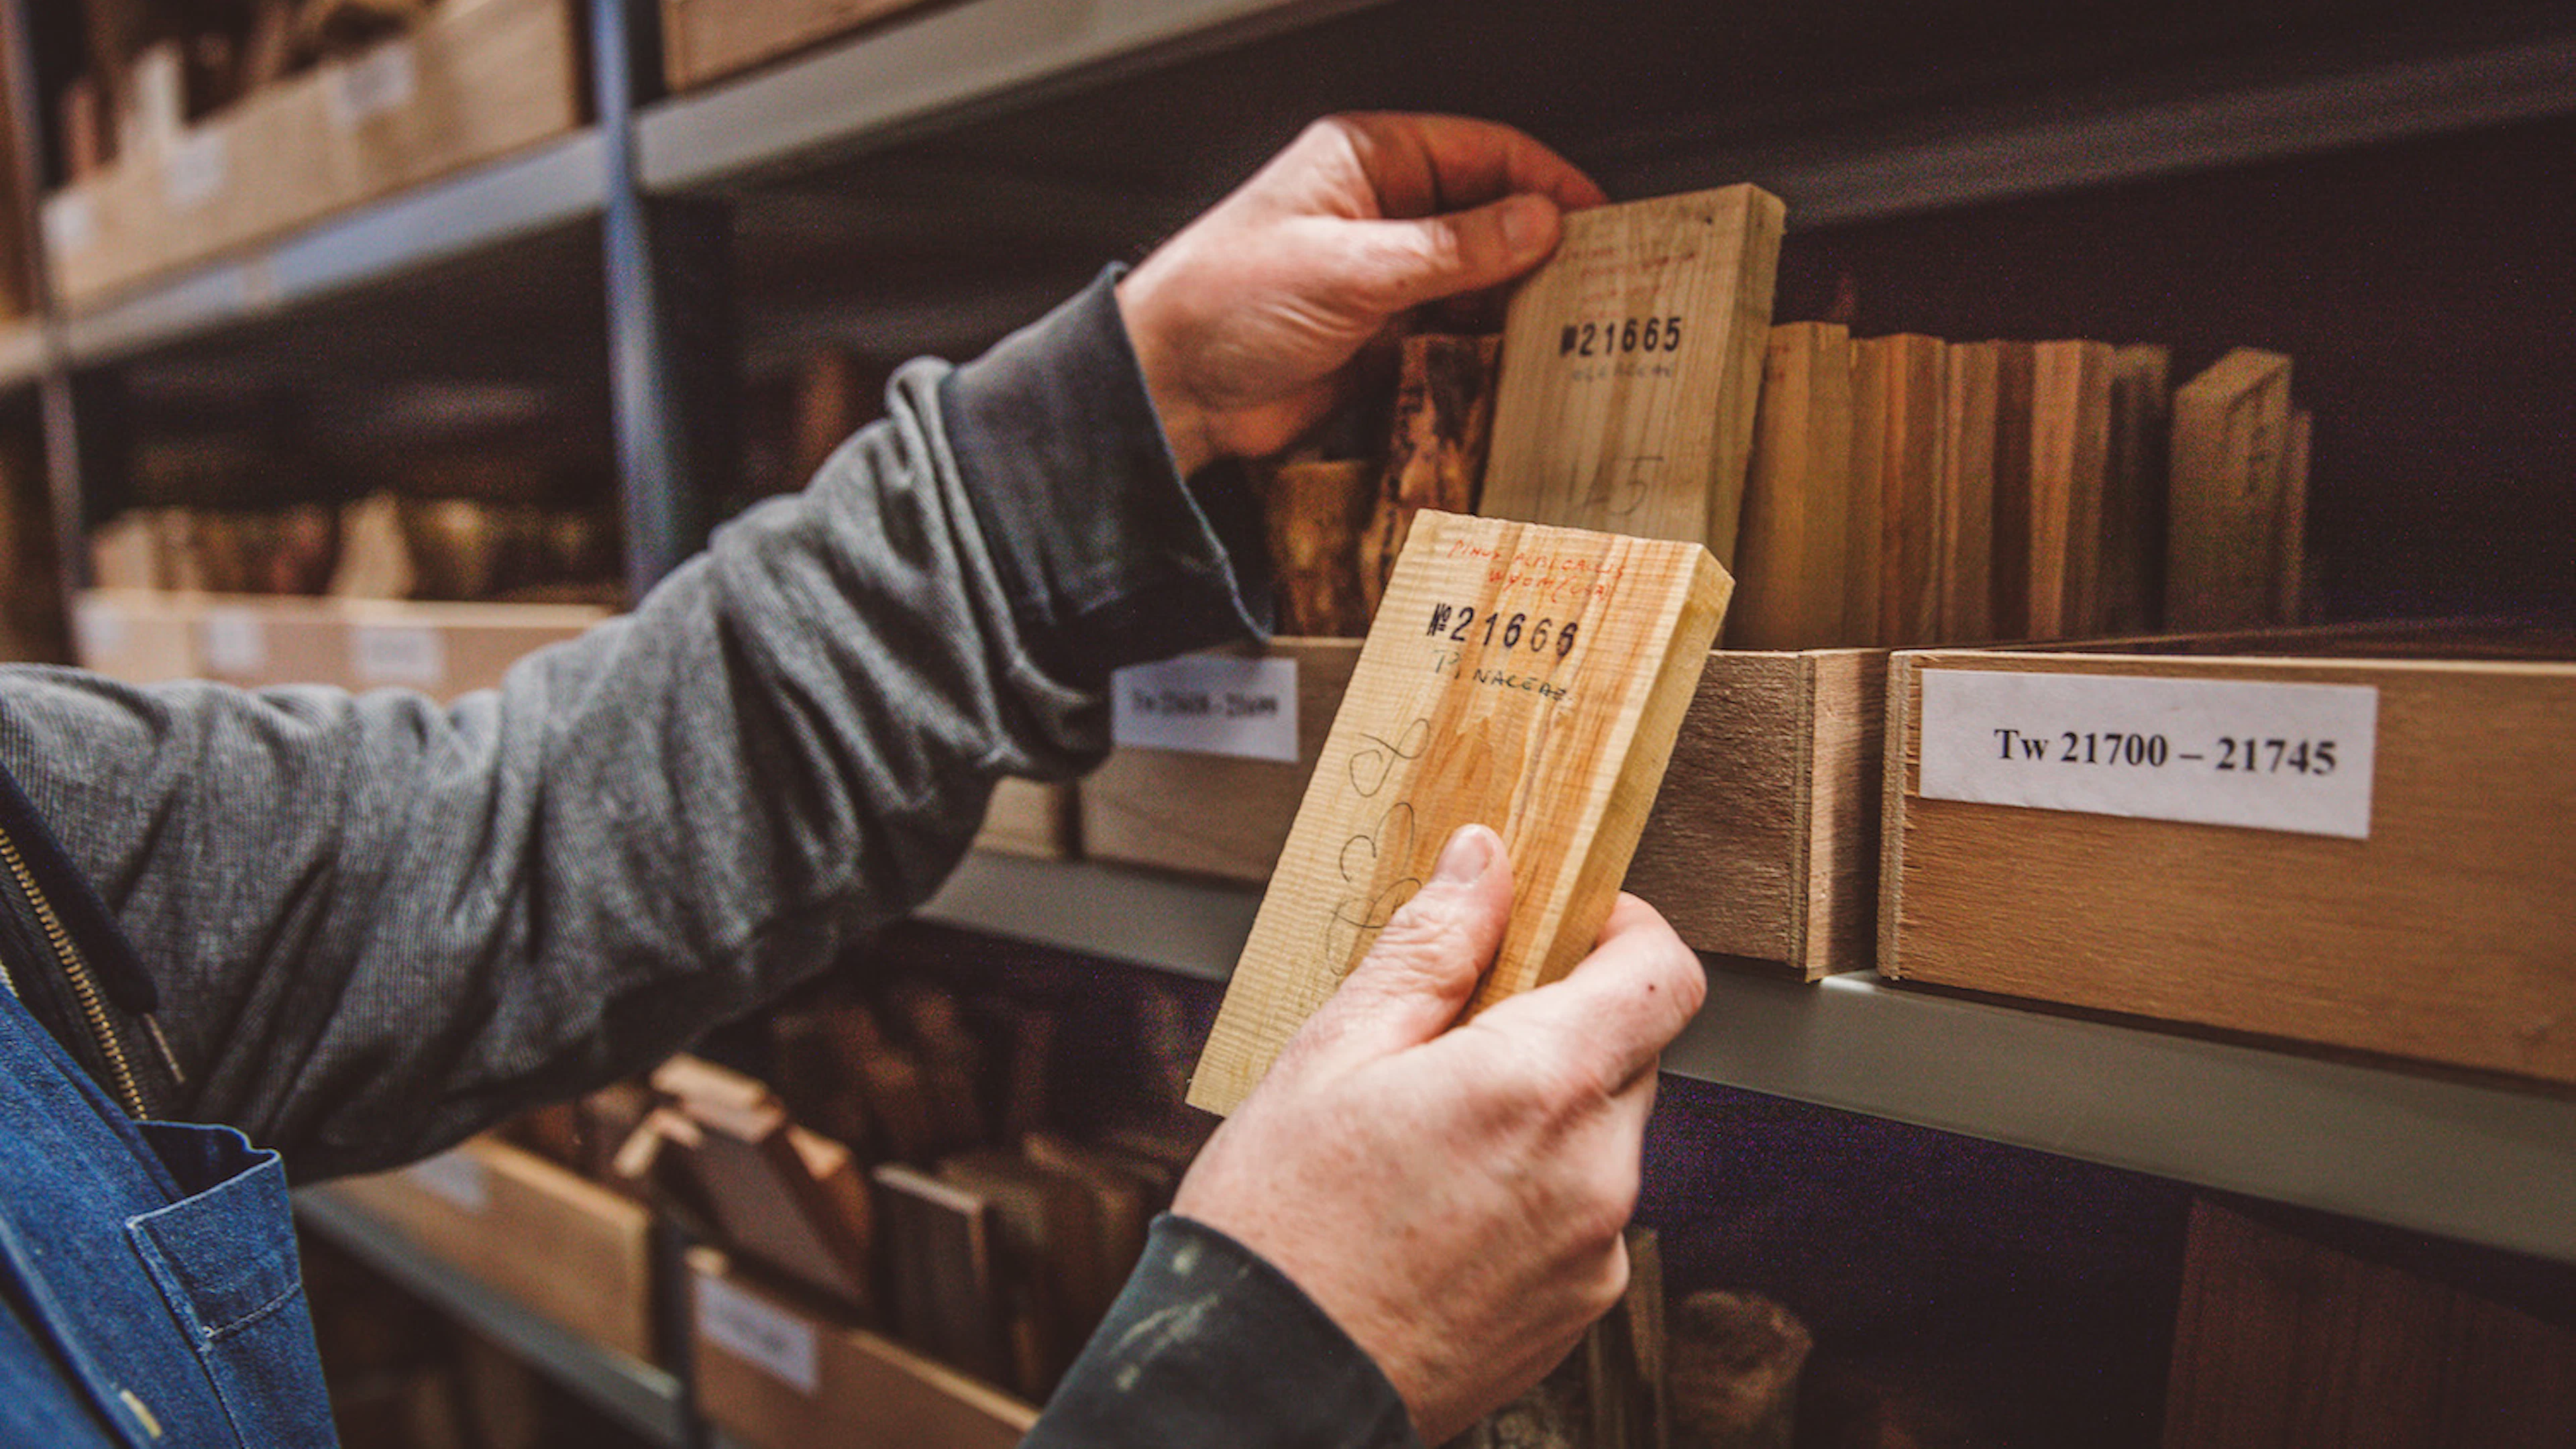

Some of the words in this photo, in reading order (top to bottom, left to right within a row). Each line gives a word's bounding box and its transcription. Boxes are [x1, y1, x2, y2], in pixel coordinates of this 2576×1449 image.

[1993, 729, 2049, 761] Tw
[2059, 731, 2168, 767] 21700
[2215, 736, 2337, 775] 21745
